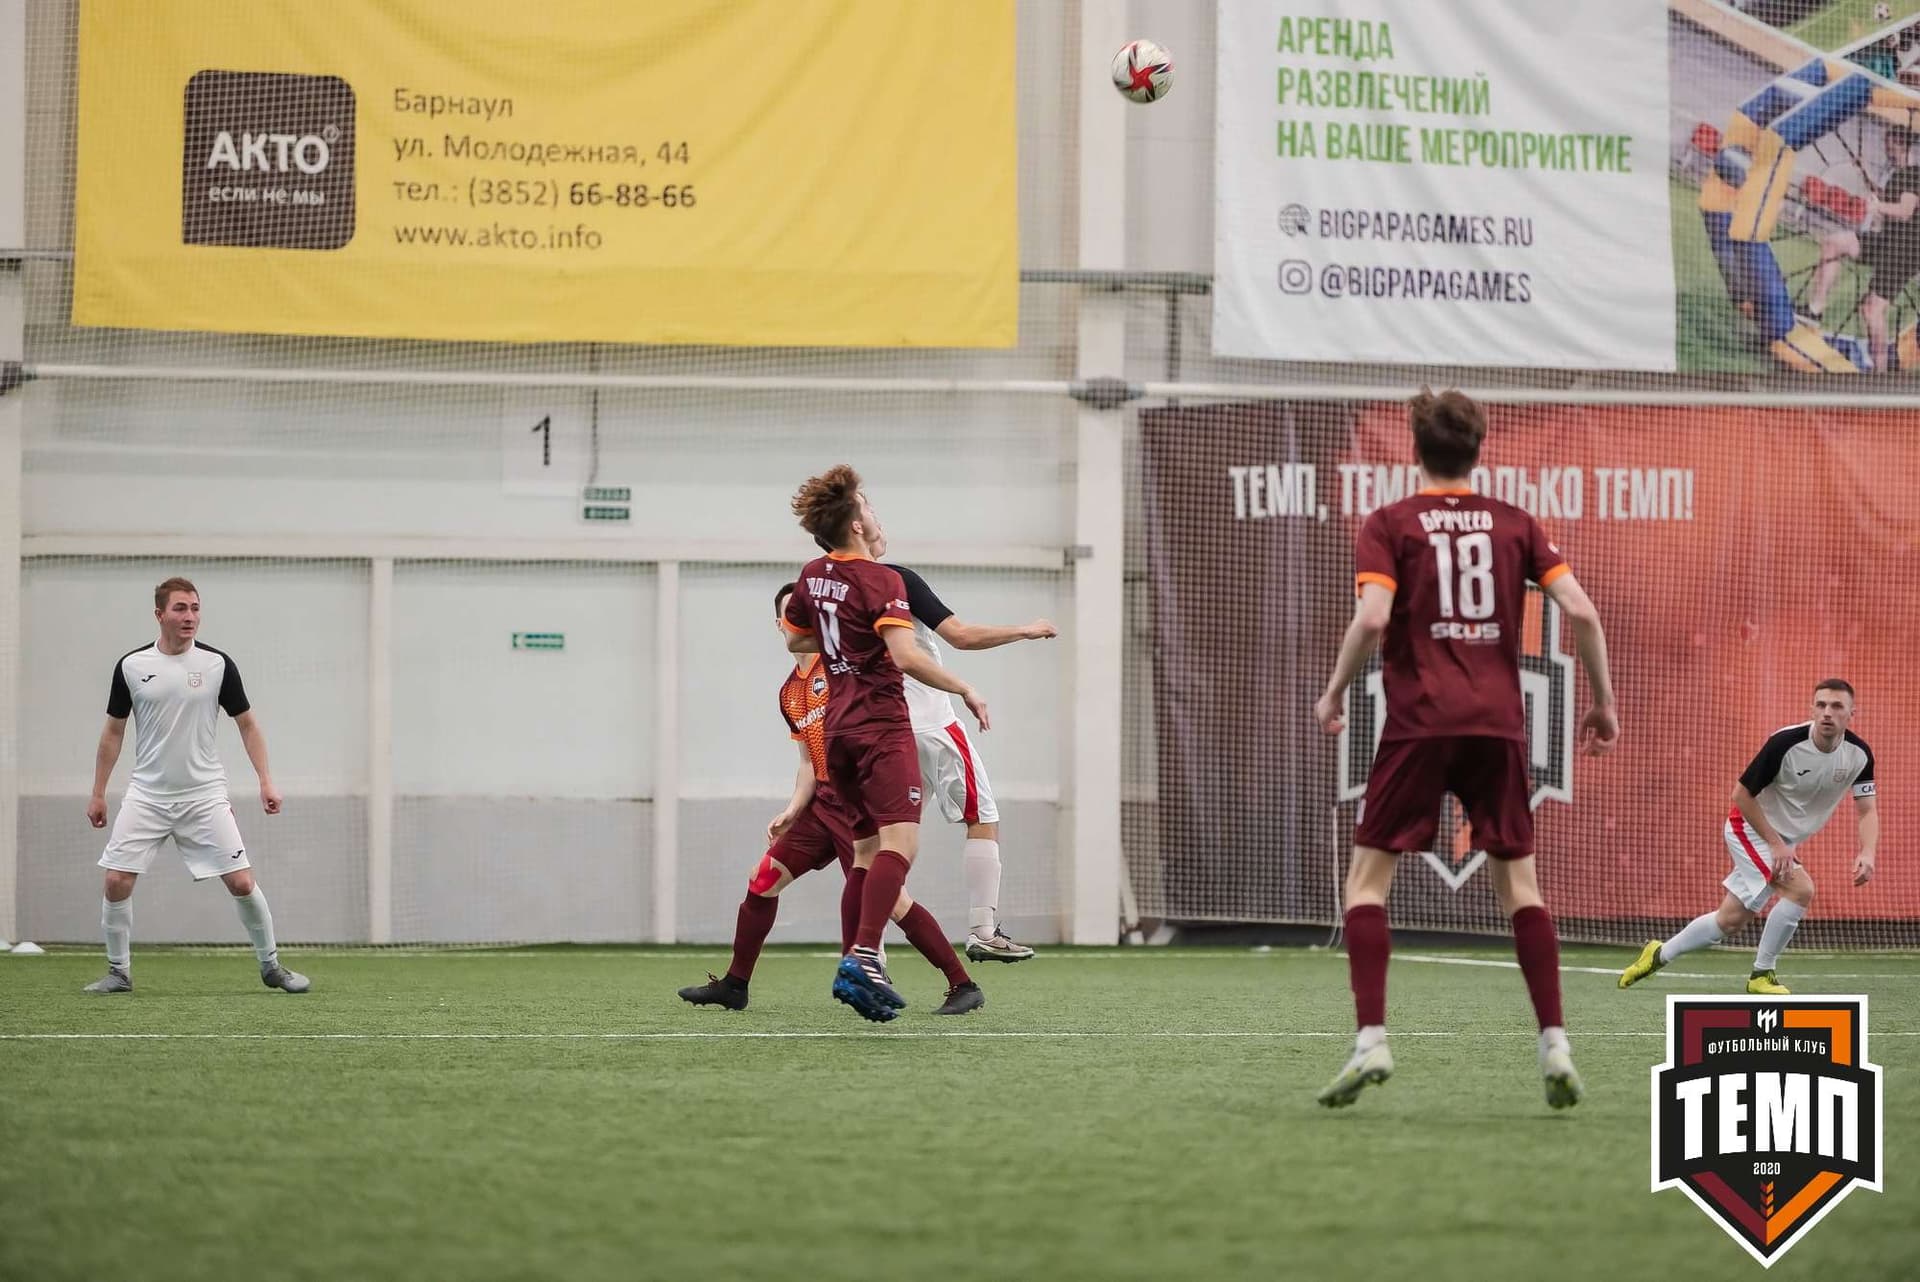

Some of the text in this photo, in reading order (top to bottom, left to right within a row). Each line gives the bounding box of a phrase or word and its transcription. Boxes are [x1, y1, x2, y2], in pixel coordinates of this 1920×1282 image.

[1276, 16, 1394, 61] АРЕНДА
[394, 87, 514, 121] Барнаул
[1276, 66, 1491, 116] РАЗВЛЕЧЕНИЙ
[393, 134, 690, 167] ул. Молодежная, 44
[1276, 120, 1633, 173] НА ВАШЕ МЕРОПРИЯТИЕ
[209, 186, 325, 205] если не мы
[393, 176, 697, 208] тел.: (3852) 66-88-66
[393, 222, 602, 250] www.akto.info
[1320, 208, 1534, 247] BIGPAPAGAMES.RU
[1320, 263, 1532, 303] @BIGPAPAGAMES
[531, 415, 550, 466] 1
[1228, 463, 1328, 522] ТЕМП,
[1470, 466, 1584, 520] ОЛЬКО
[1594, 467, 1694, 521] ТЕМП!
[1428, 532, 1496, 620] 18
